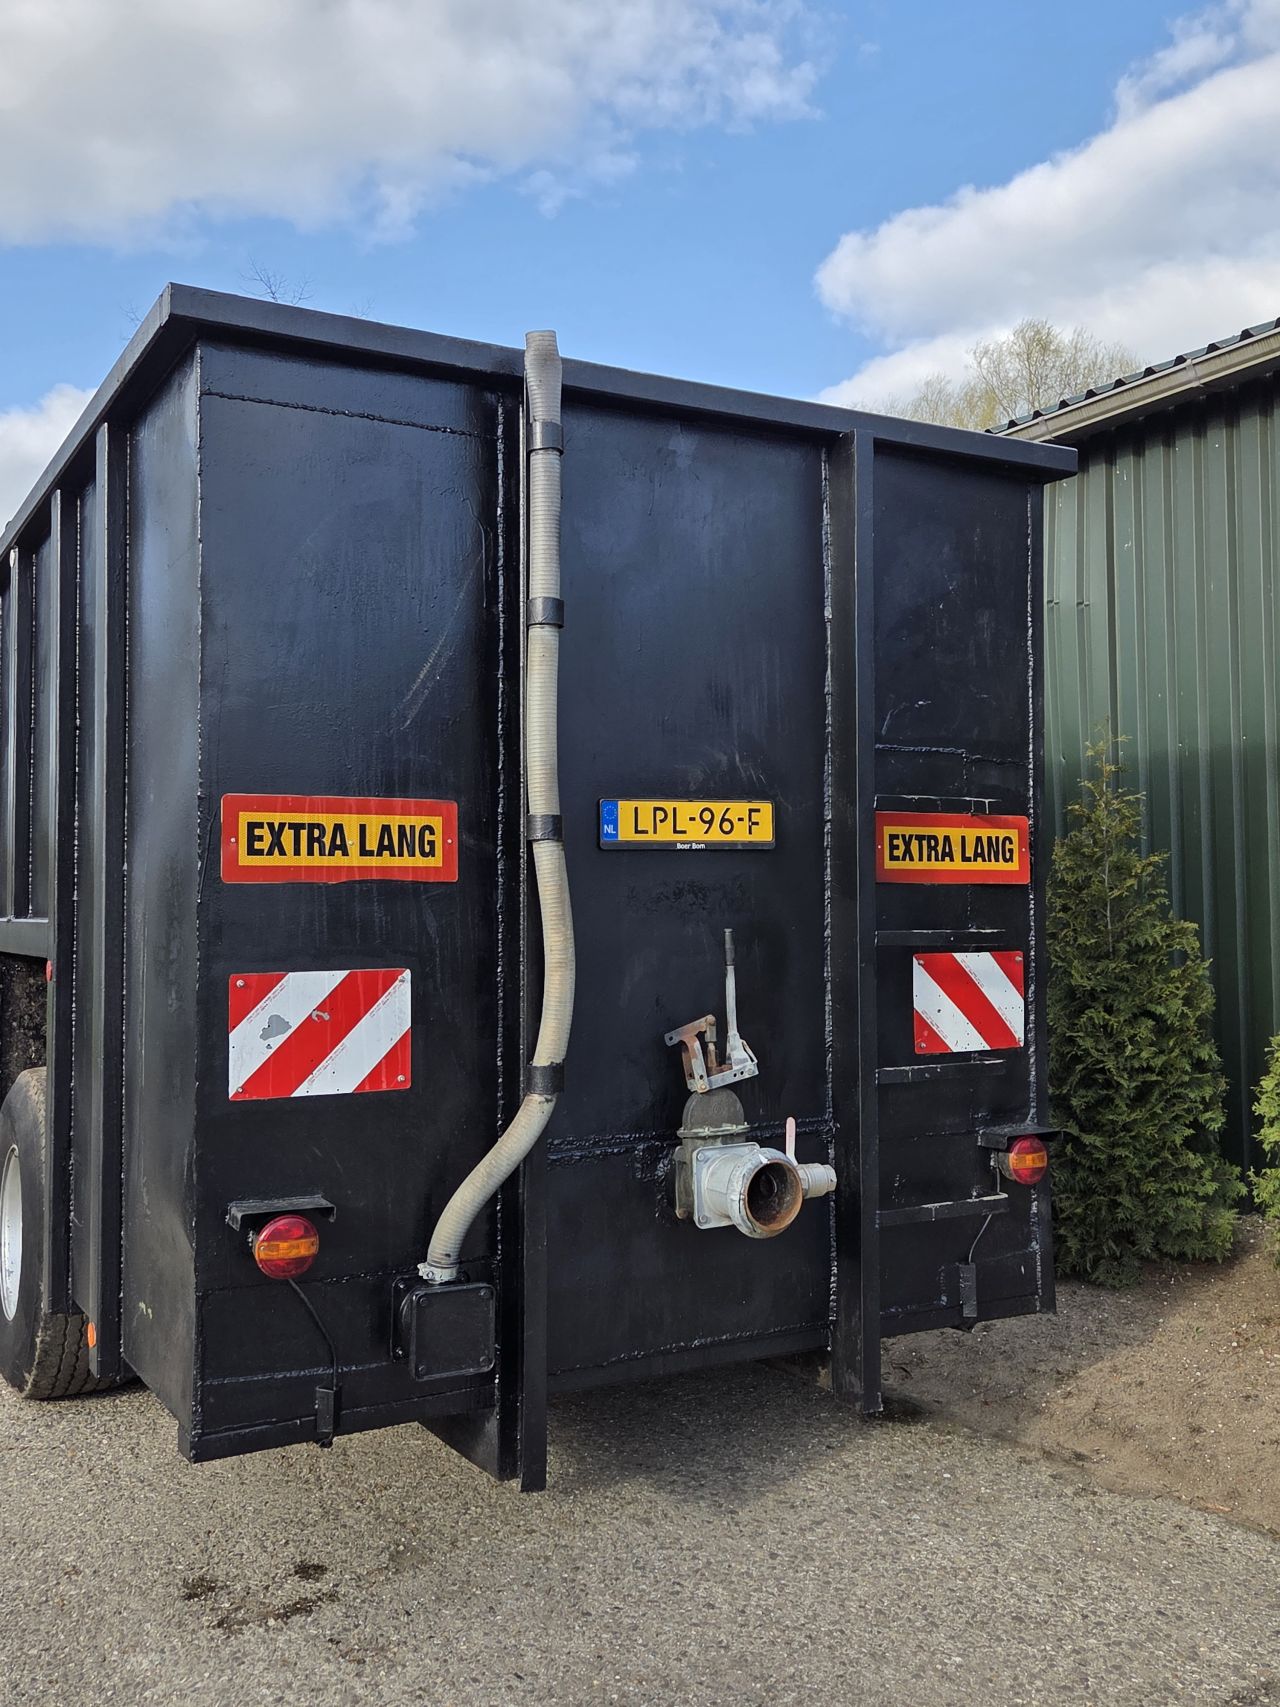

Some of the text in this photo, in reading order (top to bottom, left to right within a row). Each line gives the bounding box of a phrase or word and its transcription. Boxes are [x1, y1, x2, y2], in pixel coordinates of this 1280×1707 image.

[604, 806, 761, 835] NL LPL-96-F
[246, 821, 436, 858] EXTRA LANG
[888, 833, 1014, 863] EXTRA LANG
